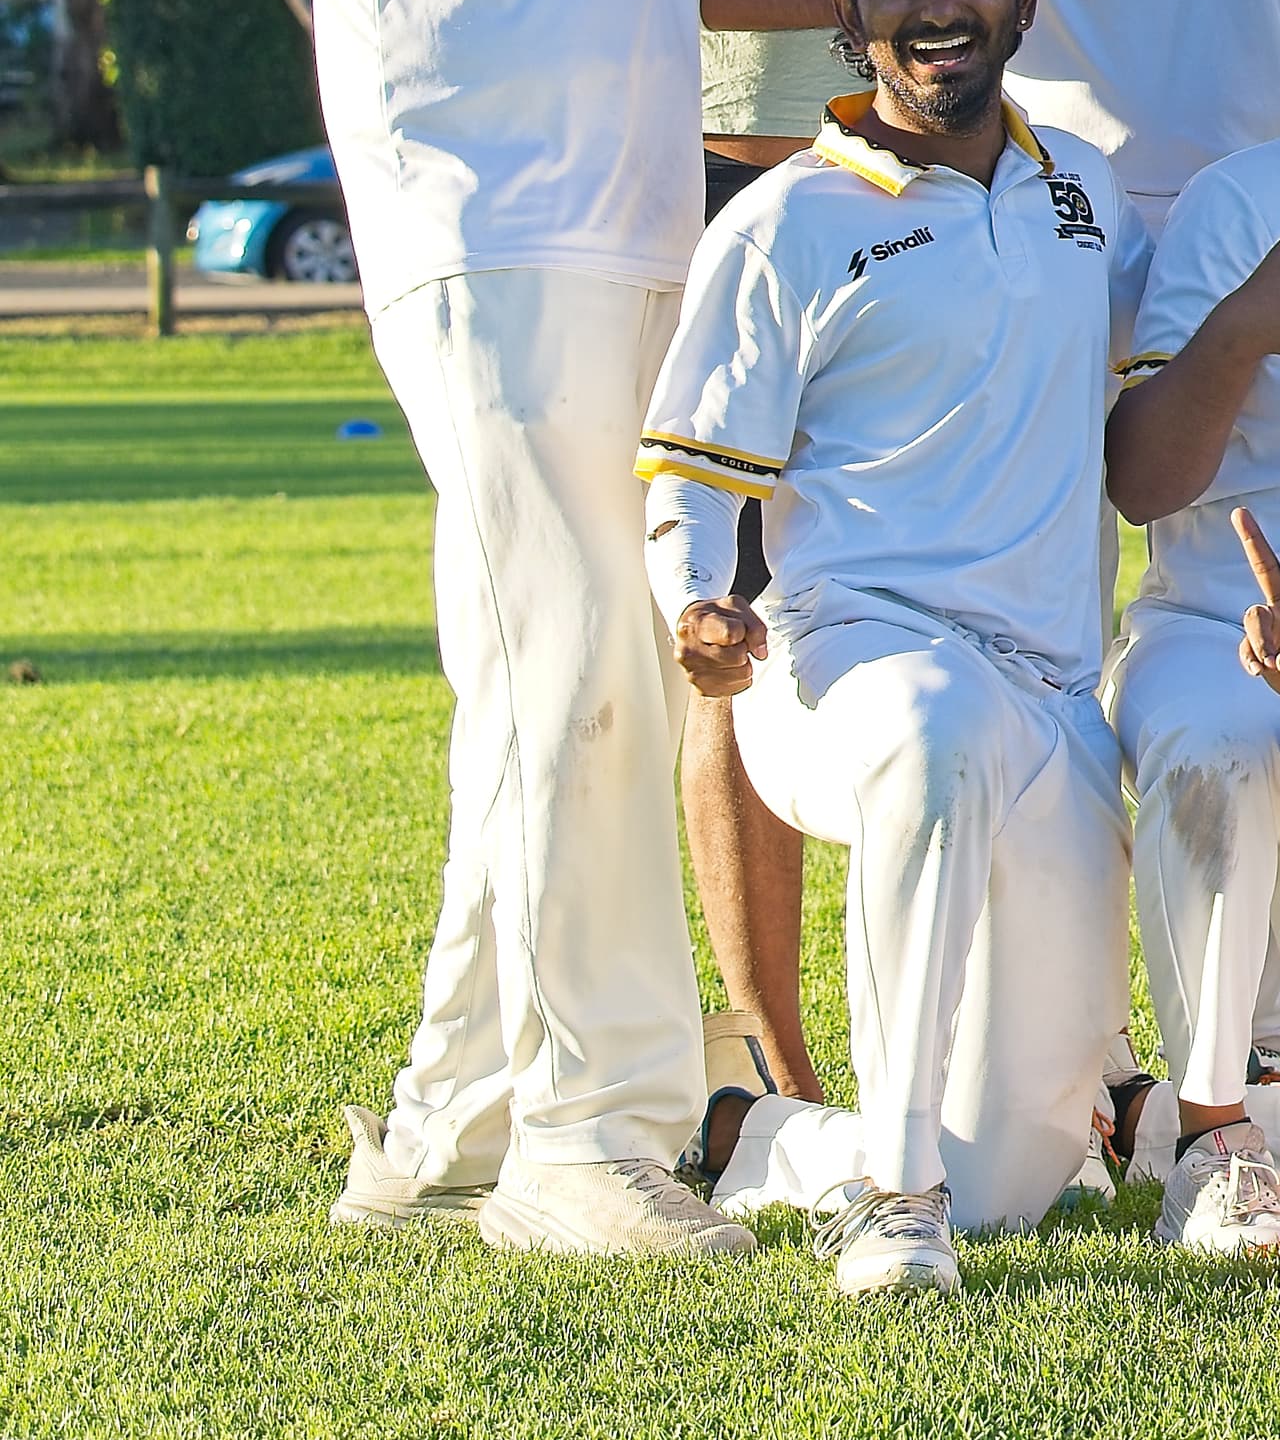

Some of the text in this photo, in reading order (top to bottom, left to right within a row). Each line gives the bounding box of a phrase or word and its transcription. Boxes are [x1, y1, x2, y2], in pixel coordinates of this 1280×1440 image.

[1046, 181, 1094, 225] 50
[870, 225, 936, 261] Sinalli
[720, 456, 755, 472] COLTS
